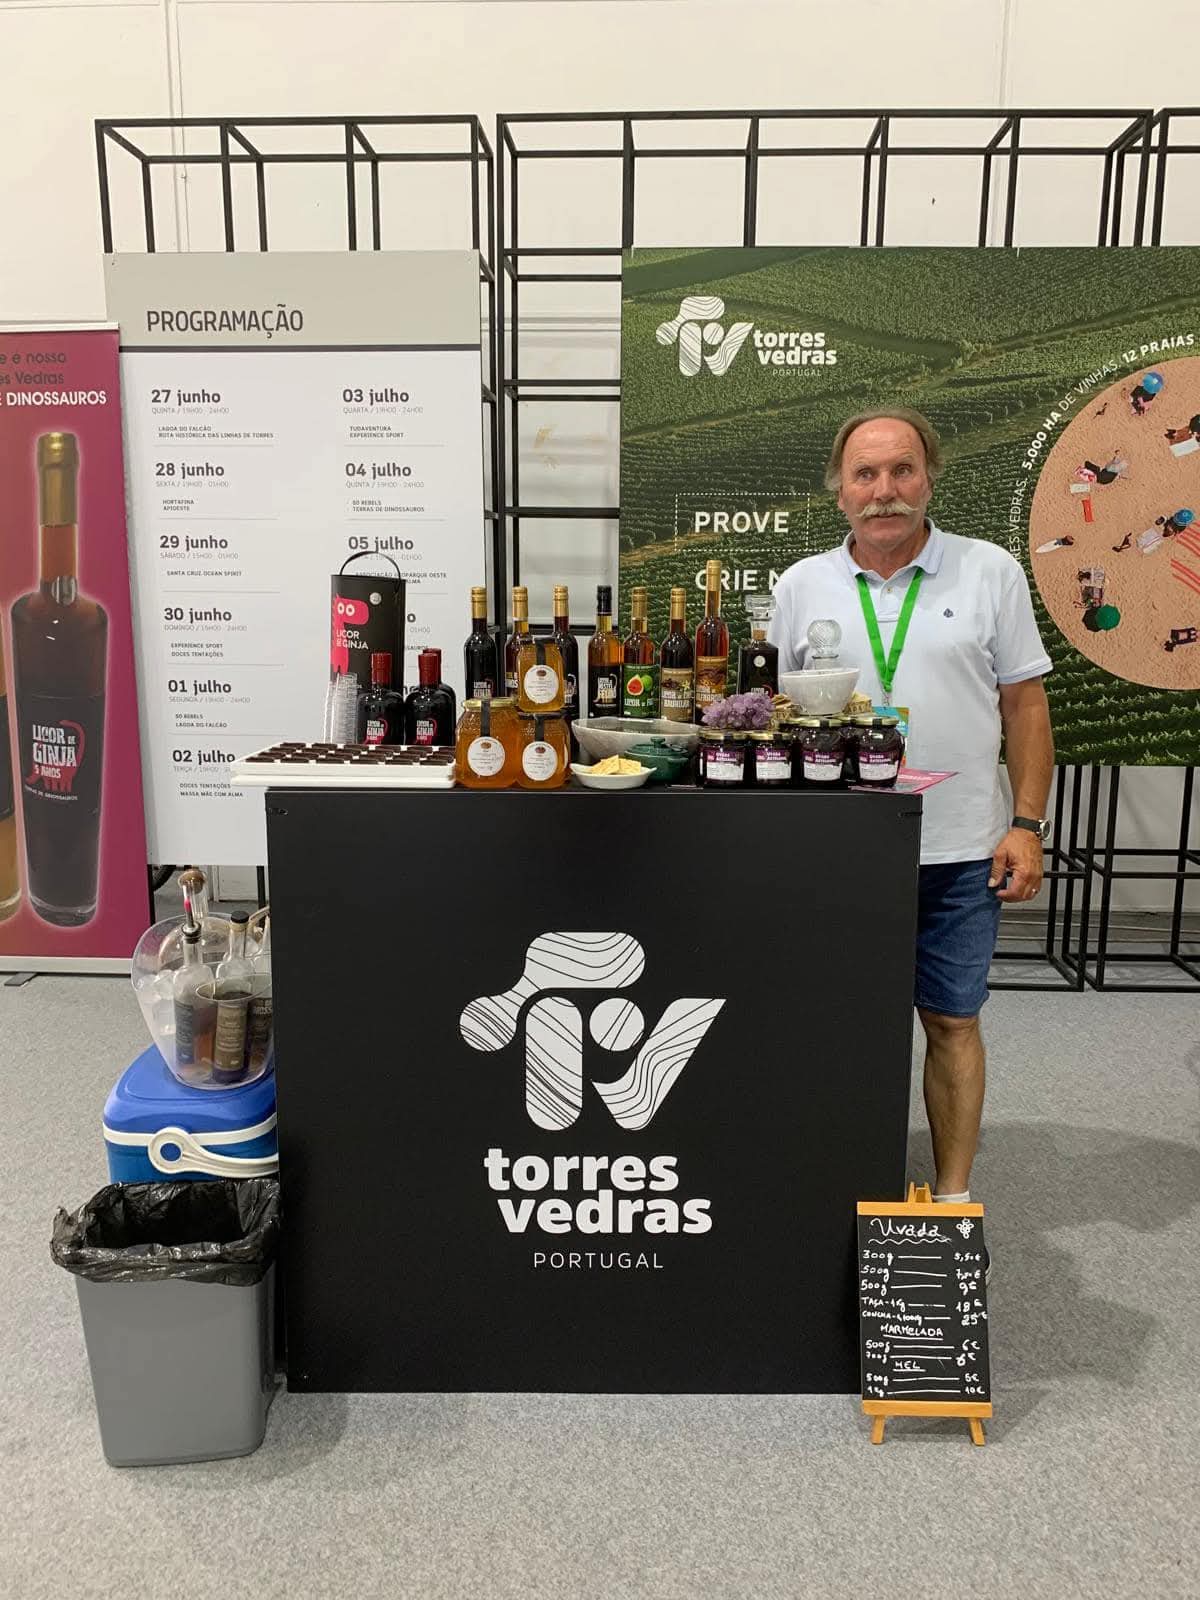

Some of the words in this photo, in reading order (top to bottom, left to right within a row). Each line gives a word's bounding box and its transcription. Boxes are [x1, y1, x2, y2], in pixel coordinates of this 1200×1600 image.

[147, 303, 303, 339] PROGRAMAÇÃO
[753, 329, 826, 348] torres
[26, 352, 66, 364] nosso
[757, 346, 837, 365] vedras
[15, 371, 65, 385] Vedras
[772, 368, 821, 377] PORTUGAL
[6, 390, 107, 406] DINOSSAUROS
[151, 389, 171, 404] 27
[177, 388, 221, 406] junho
[342, 388, 364, 403] 03
[369, 388, 409, 406] julho
[1021, 431, 1047, 470] 5.000
[1042, 411, 1062, 431] HA
[1058, 391, 1077, 411] DE
[1122, 349, 1138, 363] 12
[1140, 333, 1195, 356] PRAIAS
[155, 462, 175, 477] 28
[181, 462, 225, 479] junho
[345, 463, 367, 477] 04
[371, 462, 412, 480] julho
[694, 511, 790, 533] PROVE
[159, 535, 180, 549] 29
[185, 535, 229, 552] junho
[348, 536, 369, 550] 05
[374, 536, 414, 553] julho
[164, 607, 184, 621] 30
[188, 607, 232, 624] junho
[342, 639, 369, 650] GINJA
[168, 680, 188, 693] 01
[193, 679, 232, 696] julho
[32, 724, 66, 745] LICOR
[32, 742, 77, 768] GINJA
[172, 750, 193, 763] 02
[197, 749, 236, 765] julho
[483, 1148, 679, 1192] torres
[497, 1189, 713, 1234] vedras
[534, 1252, 664, 1269] PORTUGAL
[862, 1249, 894, 1266] 300g
[860, 1265, 890, 1283] 500g
[860, 1279, 887, 1296] 500g
[959, 1281, 977, 1296] 9€
[955, 1298, 983, 1313] 18€
[880, 1323, 944, 1337] MARMELADA
[865, 1339, 890, 1354] 500g
[895, 1360, 921, 1370] MEL
[866, 1372, 889, 1387] 500g
